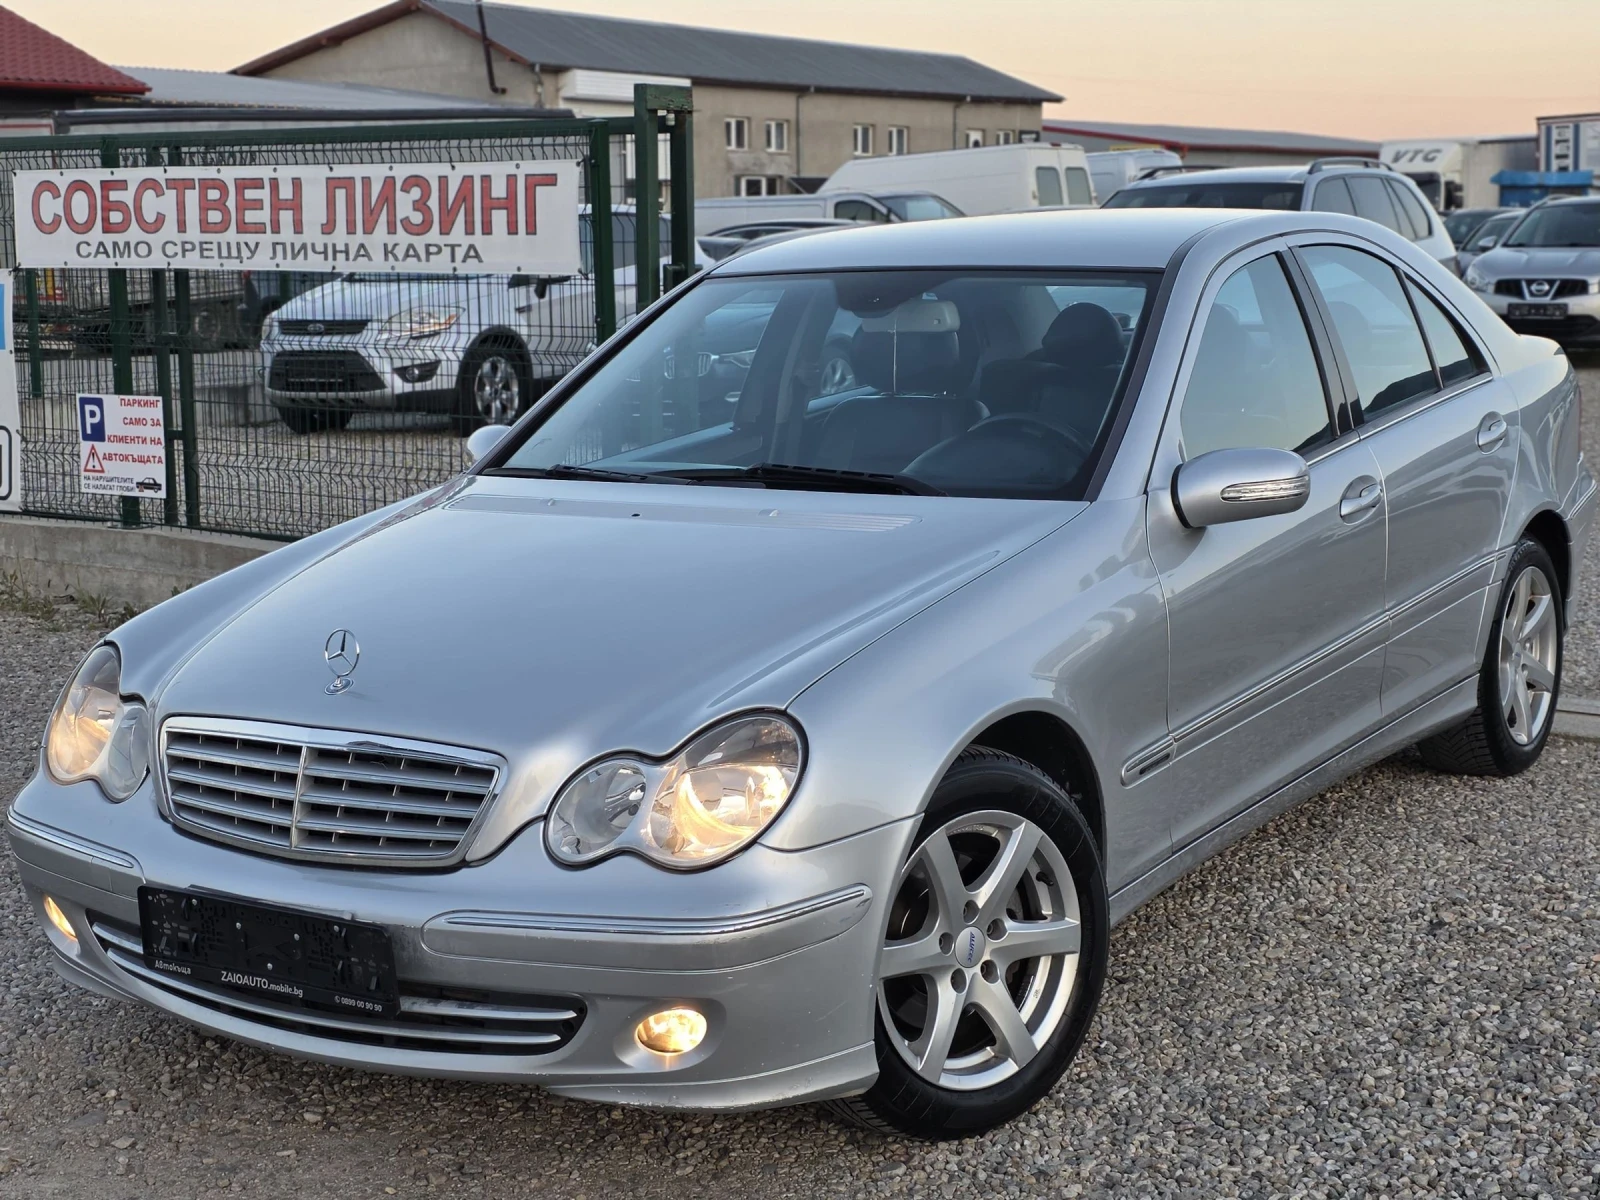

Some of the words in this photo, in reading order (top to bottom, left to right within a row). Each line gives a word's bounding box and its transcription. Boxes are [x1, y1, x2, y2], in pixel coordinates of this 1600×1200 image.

[1391, 148, 1442, 163] VTG
[31, 177, 304, 235] СОБСТВЕН
[321, 173, 558, 236] ЛИЗИНГ
[75, 240, 153, 259] САМО
[161, 240, 260, 262] СРЕЩУ
[269, 241, 373, 262] ЛИЧНА
[384, 243, 484, 263] КАРТА
[120, 398, 160, 408] ПАРКИНГ
[122, 416, 148, 427] САМО
[150, 418, 161, 427] ЗА
[107, 434, 147, 445] КЛИЕНТИ
[150, 436, 163, 446] НА
[102, 453, 163, 464] АВТОКЪЩАТА
[92, 475, 134, 484] НАРУШИТЕЛИТЕ
[155, 960, 192, 975] Автокъща
[220, 970, 304, 998] ZAIOAUTO.mobile.bg
